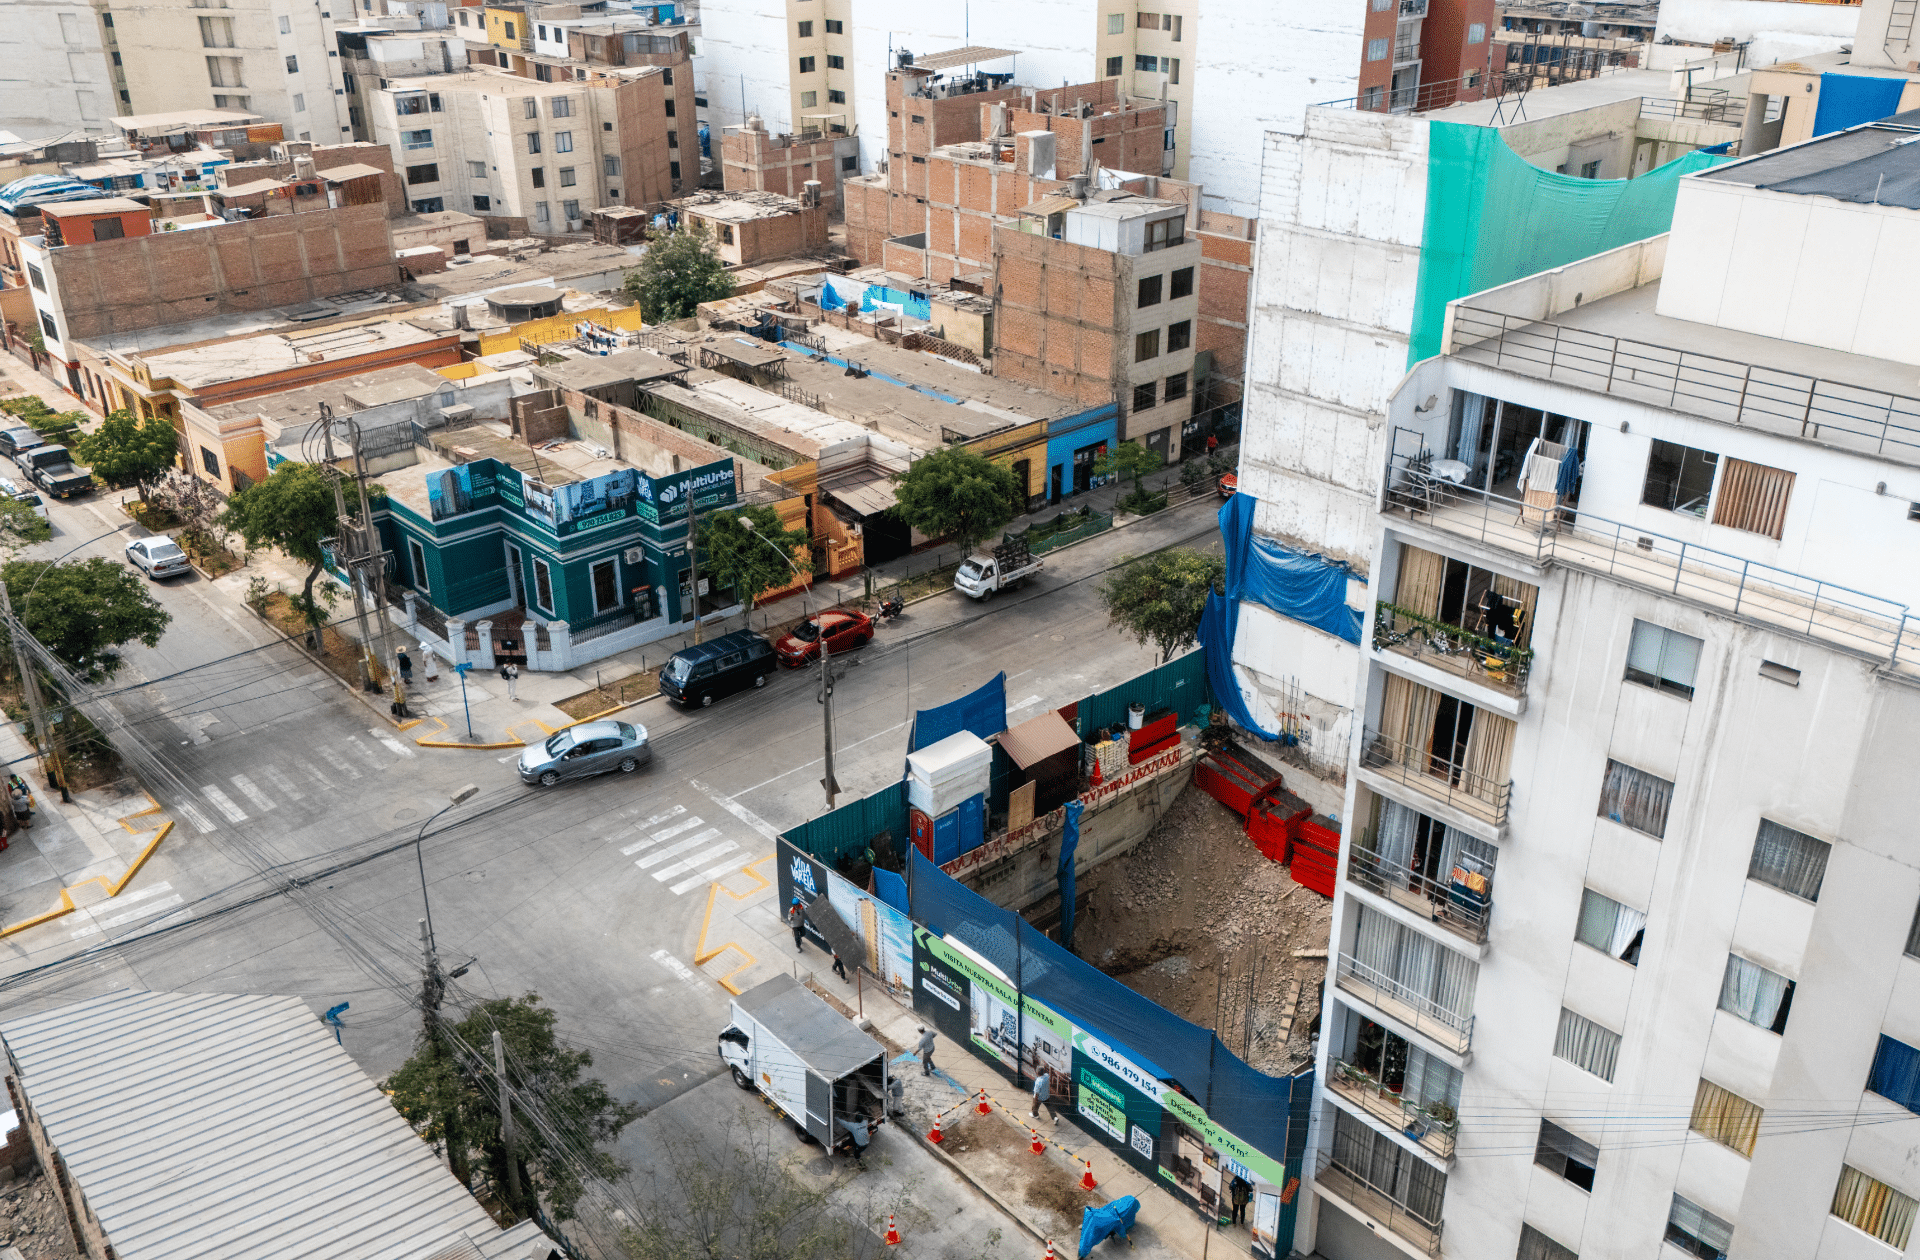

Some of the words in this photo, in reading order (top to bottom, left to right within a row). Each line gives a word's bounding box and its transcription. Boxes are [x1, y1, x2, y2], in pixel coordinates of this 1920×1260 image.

[679, 469, 734, 493] MultiUrbe
[793, 855, 812, 874] VIDA
[943, 951, 964, 969] VISITA
[964, 965, 994, 990] NUESTRA
[995, 986, 1013, 1002] SALA
[1026, 1004, 1054, 1026] VENTAS
[1101, 1052, 1120, 1070] 986
[1122, 1067, 1139, 1082] 479
[1141, 1080, 1157, 1096] 154
[1170, 1099, 1197, 1121] Desde
